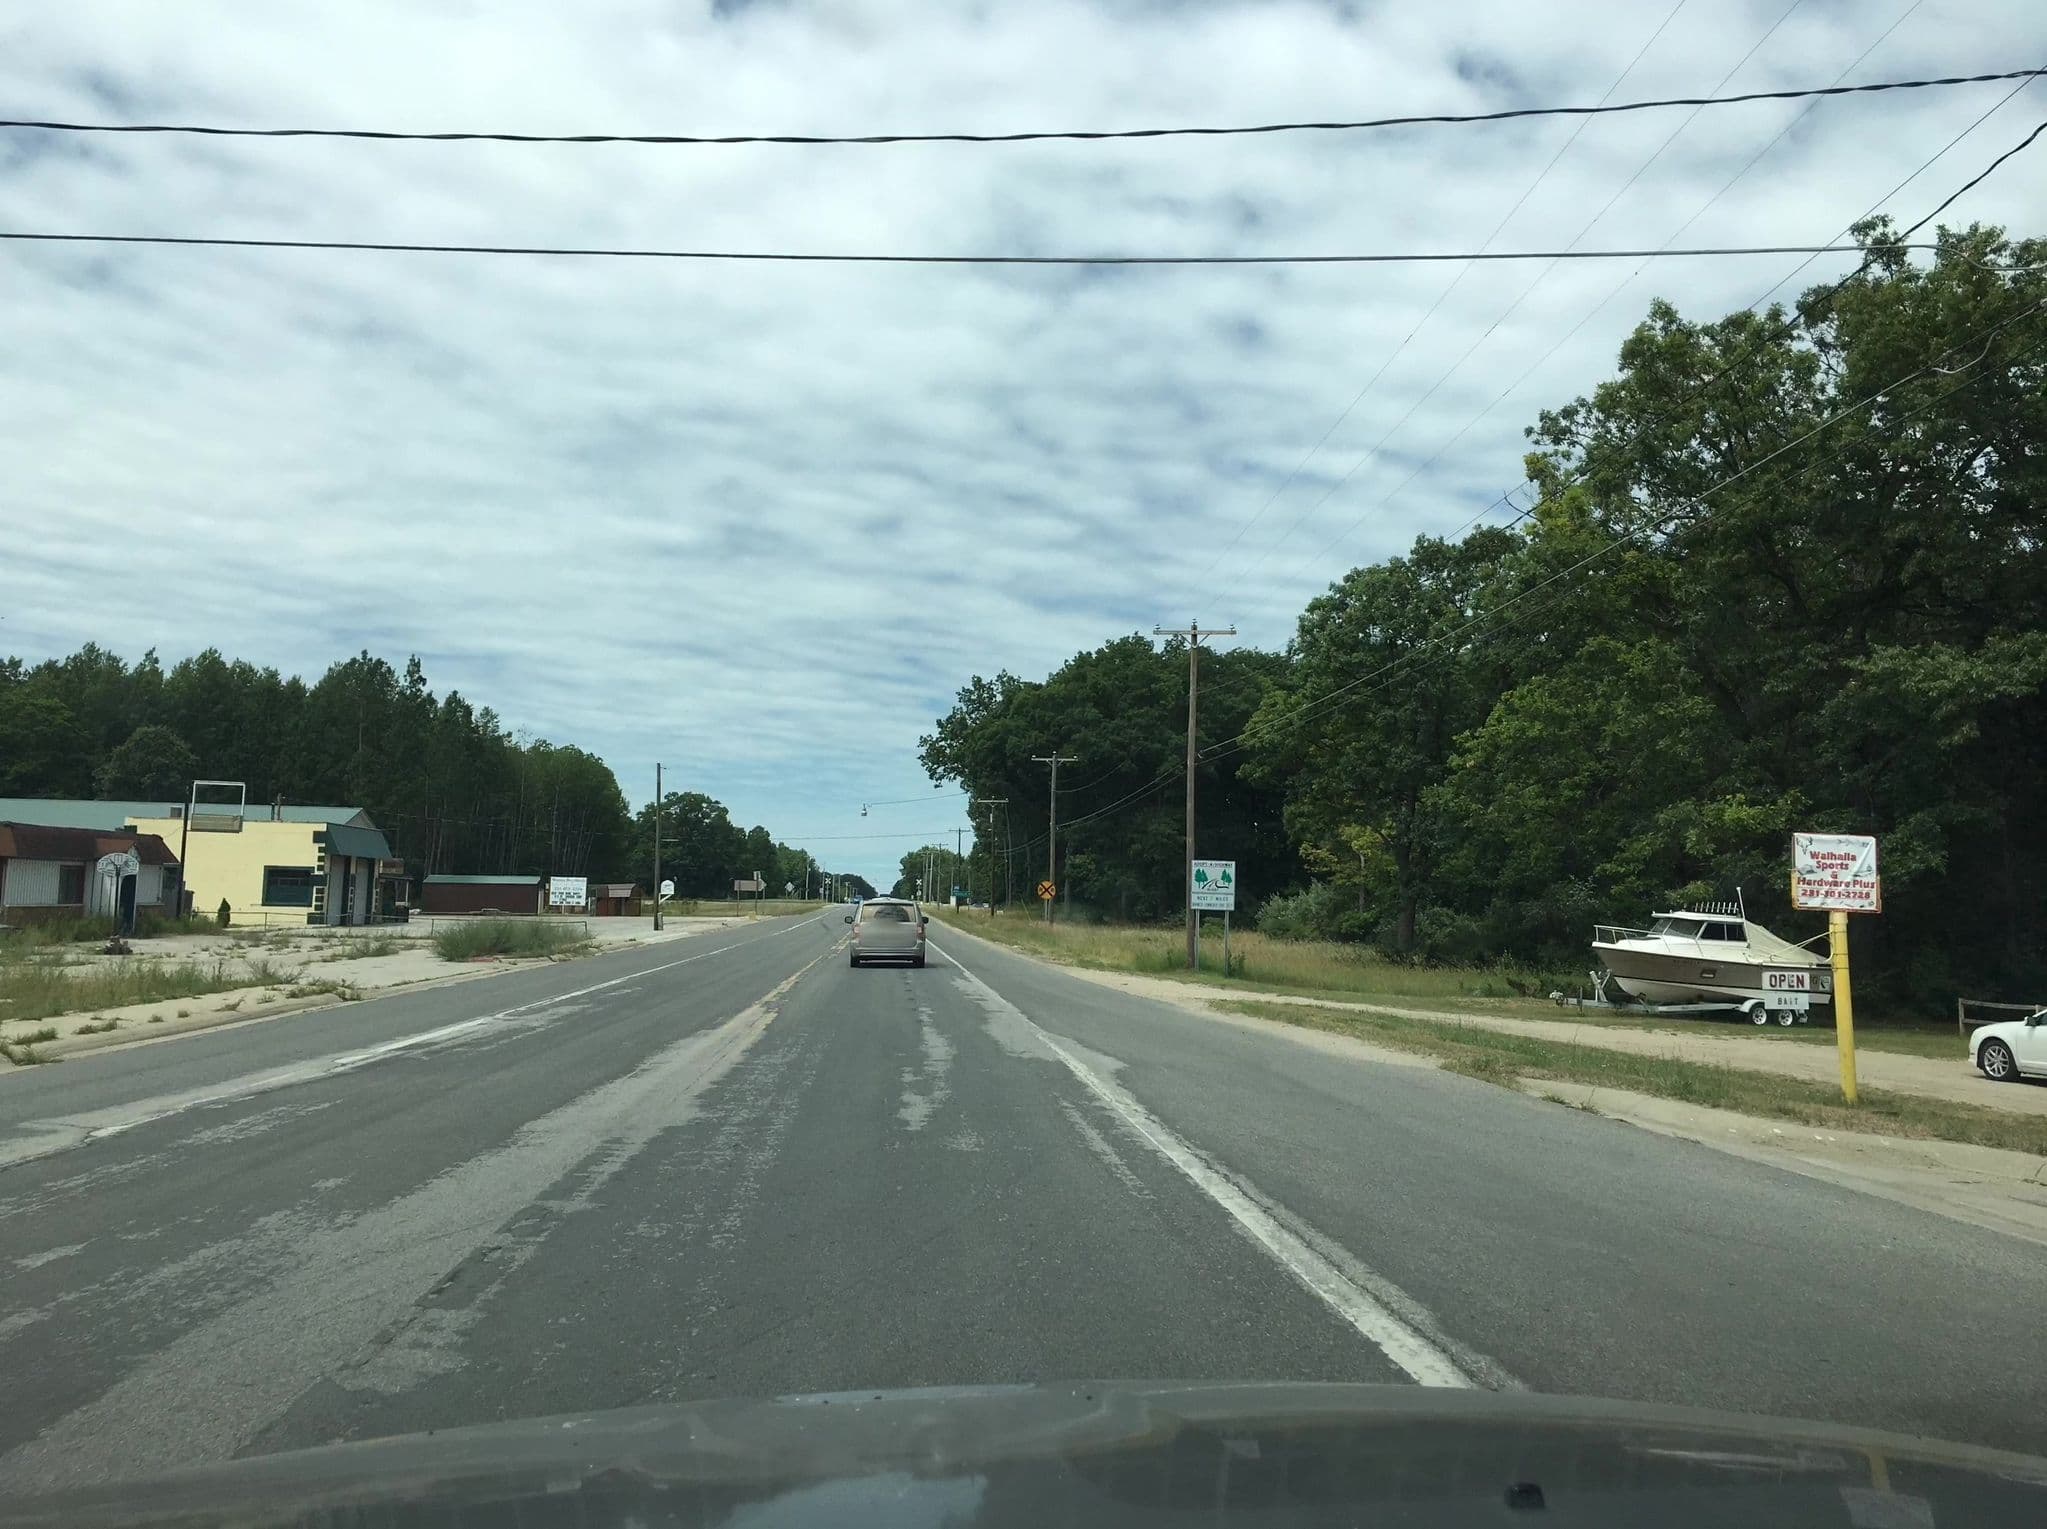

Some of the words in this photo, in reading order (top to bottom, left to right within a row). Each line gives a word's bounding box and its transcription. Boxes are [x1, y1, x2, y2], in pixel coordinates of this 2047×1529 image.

[1809, 850, 1857, 862] Walhalla
[1816, 860, 1849, 871] Sports
[1797, 877, 1851, 888] Hardware
[1853, 879, 1875, 889] Plus
[1769, 974, 1805, 988] OPEN
